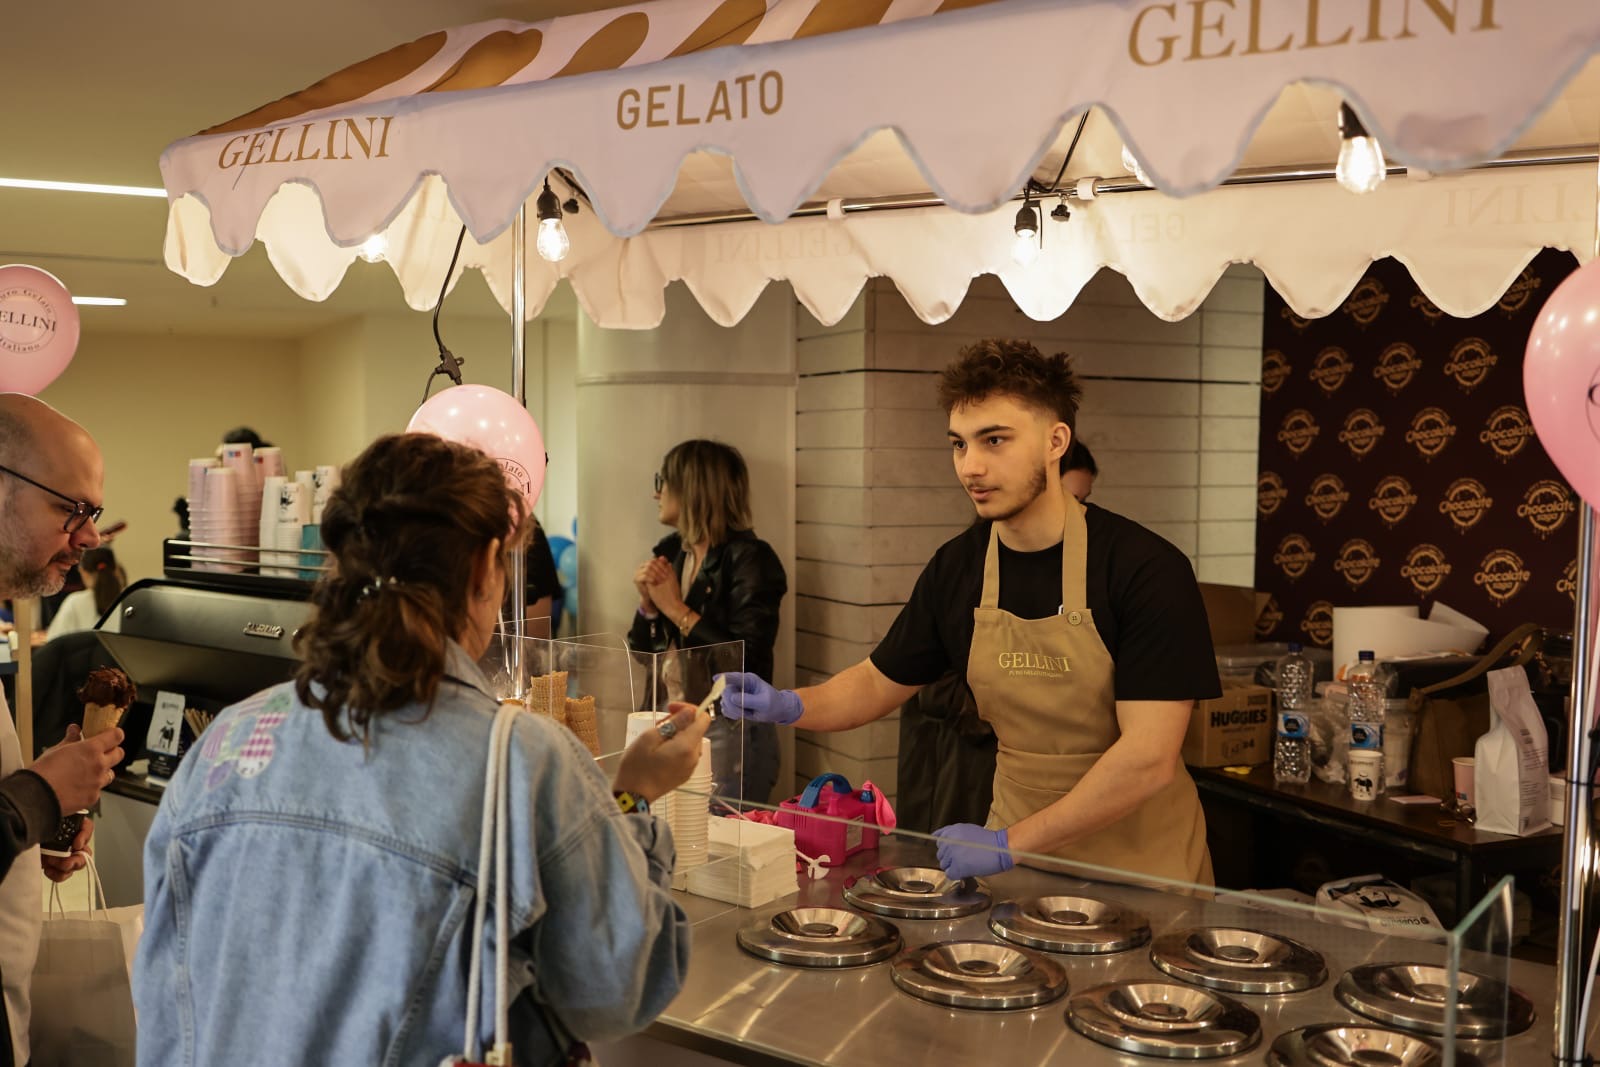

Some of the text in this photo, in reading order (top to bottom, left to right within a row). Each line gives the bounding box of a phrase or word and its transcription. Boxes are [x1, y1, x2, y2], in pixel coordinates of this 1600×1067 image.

[1128, 0, 1504, 67] GELLINI
[616, 70, 784, 130] GELATO
[218, 116, 394, 170] GELLINI
[1439, 496, 1493, 514] Chocolate
[1517, 500, 1575, 518] Chocolate
[1400, 563, 1452, 577] Chocolate
[1474, 570, 1531, 585] Chocolate
[998, 652, 1072, 672] GELLINI
[1210, 708, 1268, 728] HUGGIES
